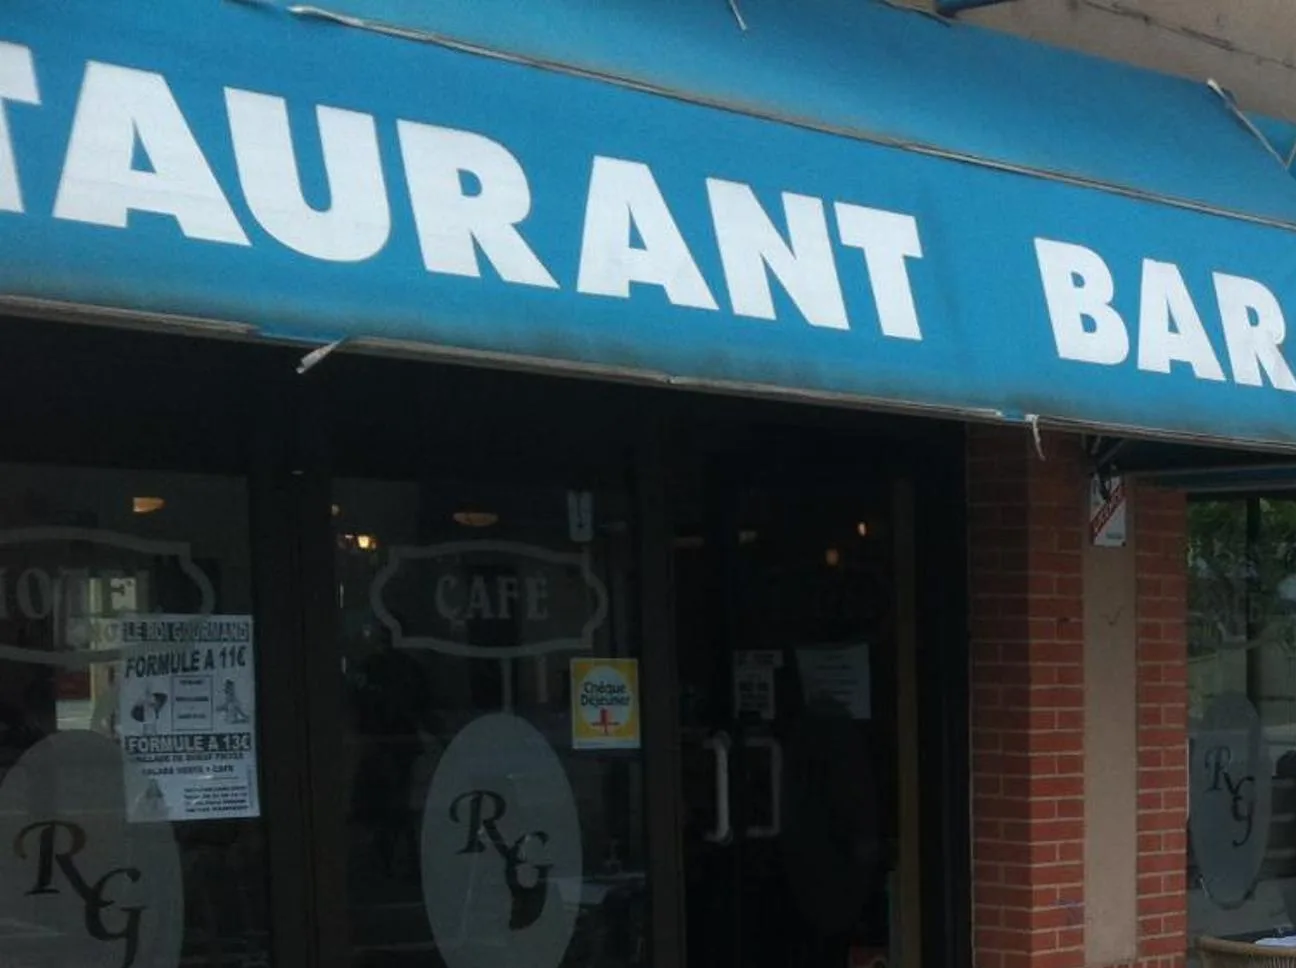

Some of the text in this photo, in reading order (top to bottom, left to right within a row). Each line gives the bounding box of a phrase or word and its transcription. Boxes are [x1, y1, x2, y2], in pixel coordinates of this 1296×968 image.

[124, 649, 201, 679] FORMULE
[203, 648, 216, 670] A
[128, 735, 205, 753] FORMULE
